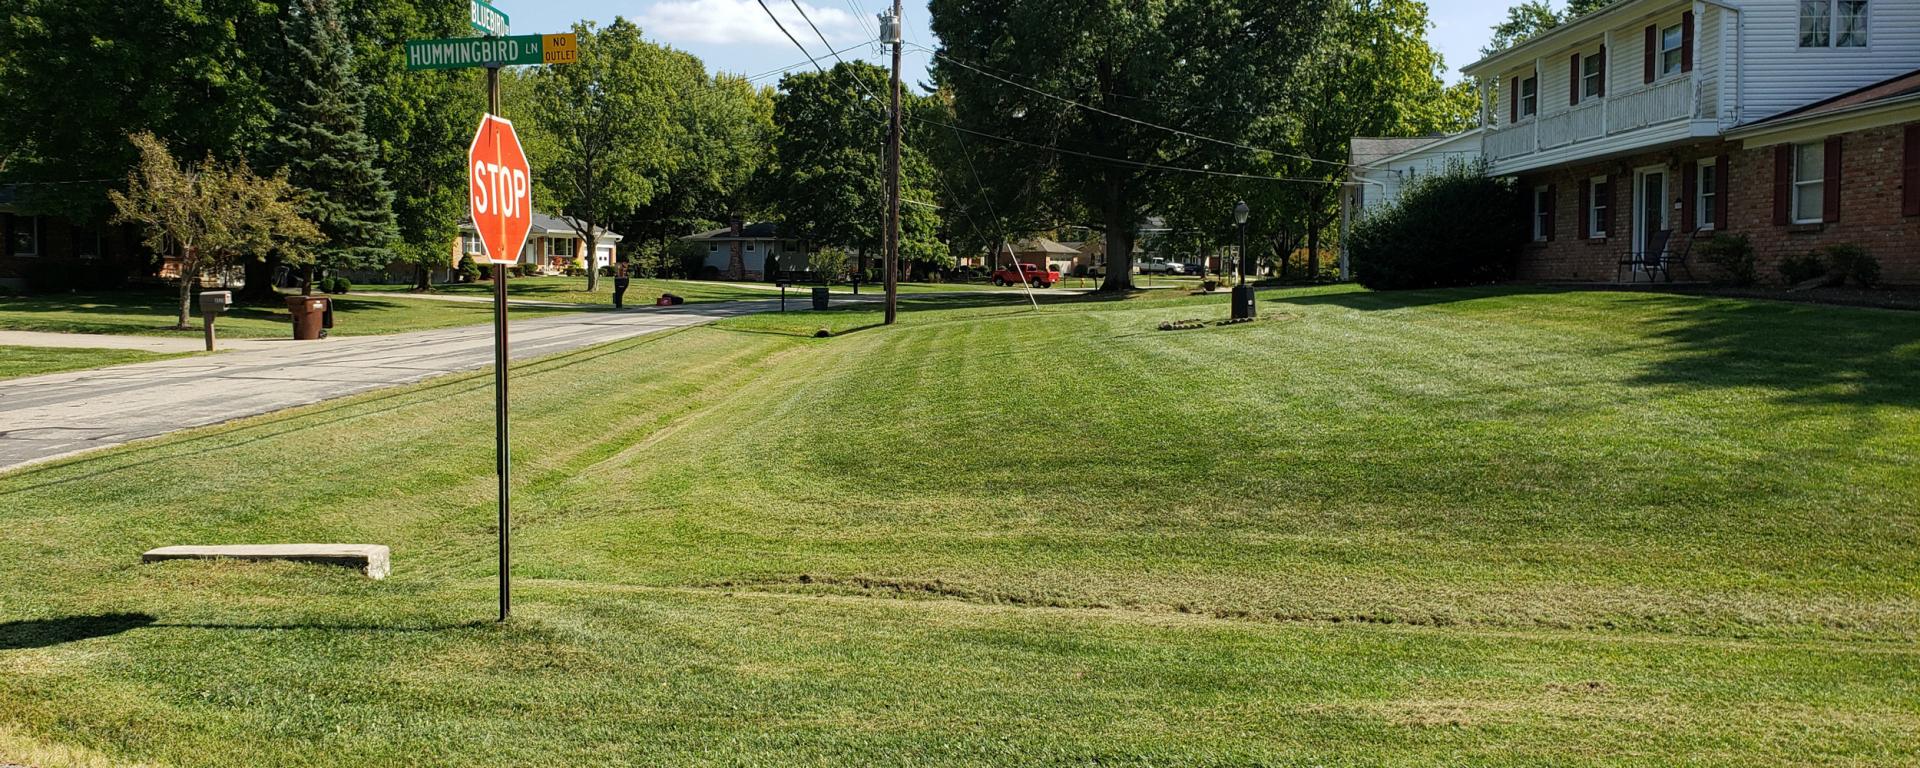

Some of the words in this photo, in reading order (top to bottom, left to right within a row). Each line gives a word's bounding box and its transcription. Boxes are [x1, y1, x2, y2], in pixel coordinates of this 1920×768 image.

[471, 0, 505, 37] BLUEBIRD
[410, 40, 519, 66] HUMMINGBIRD
[525, 42, 538, 55] LN
[553, 36, 566, 47] NO
[545, 50, 575, 62] OUTLET
[474, 159, 526, 219] STOP
